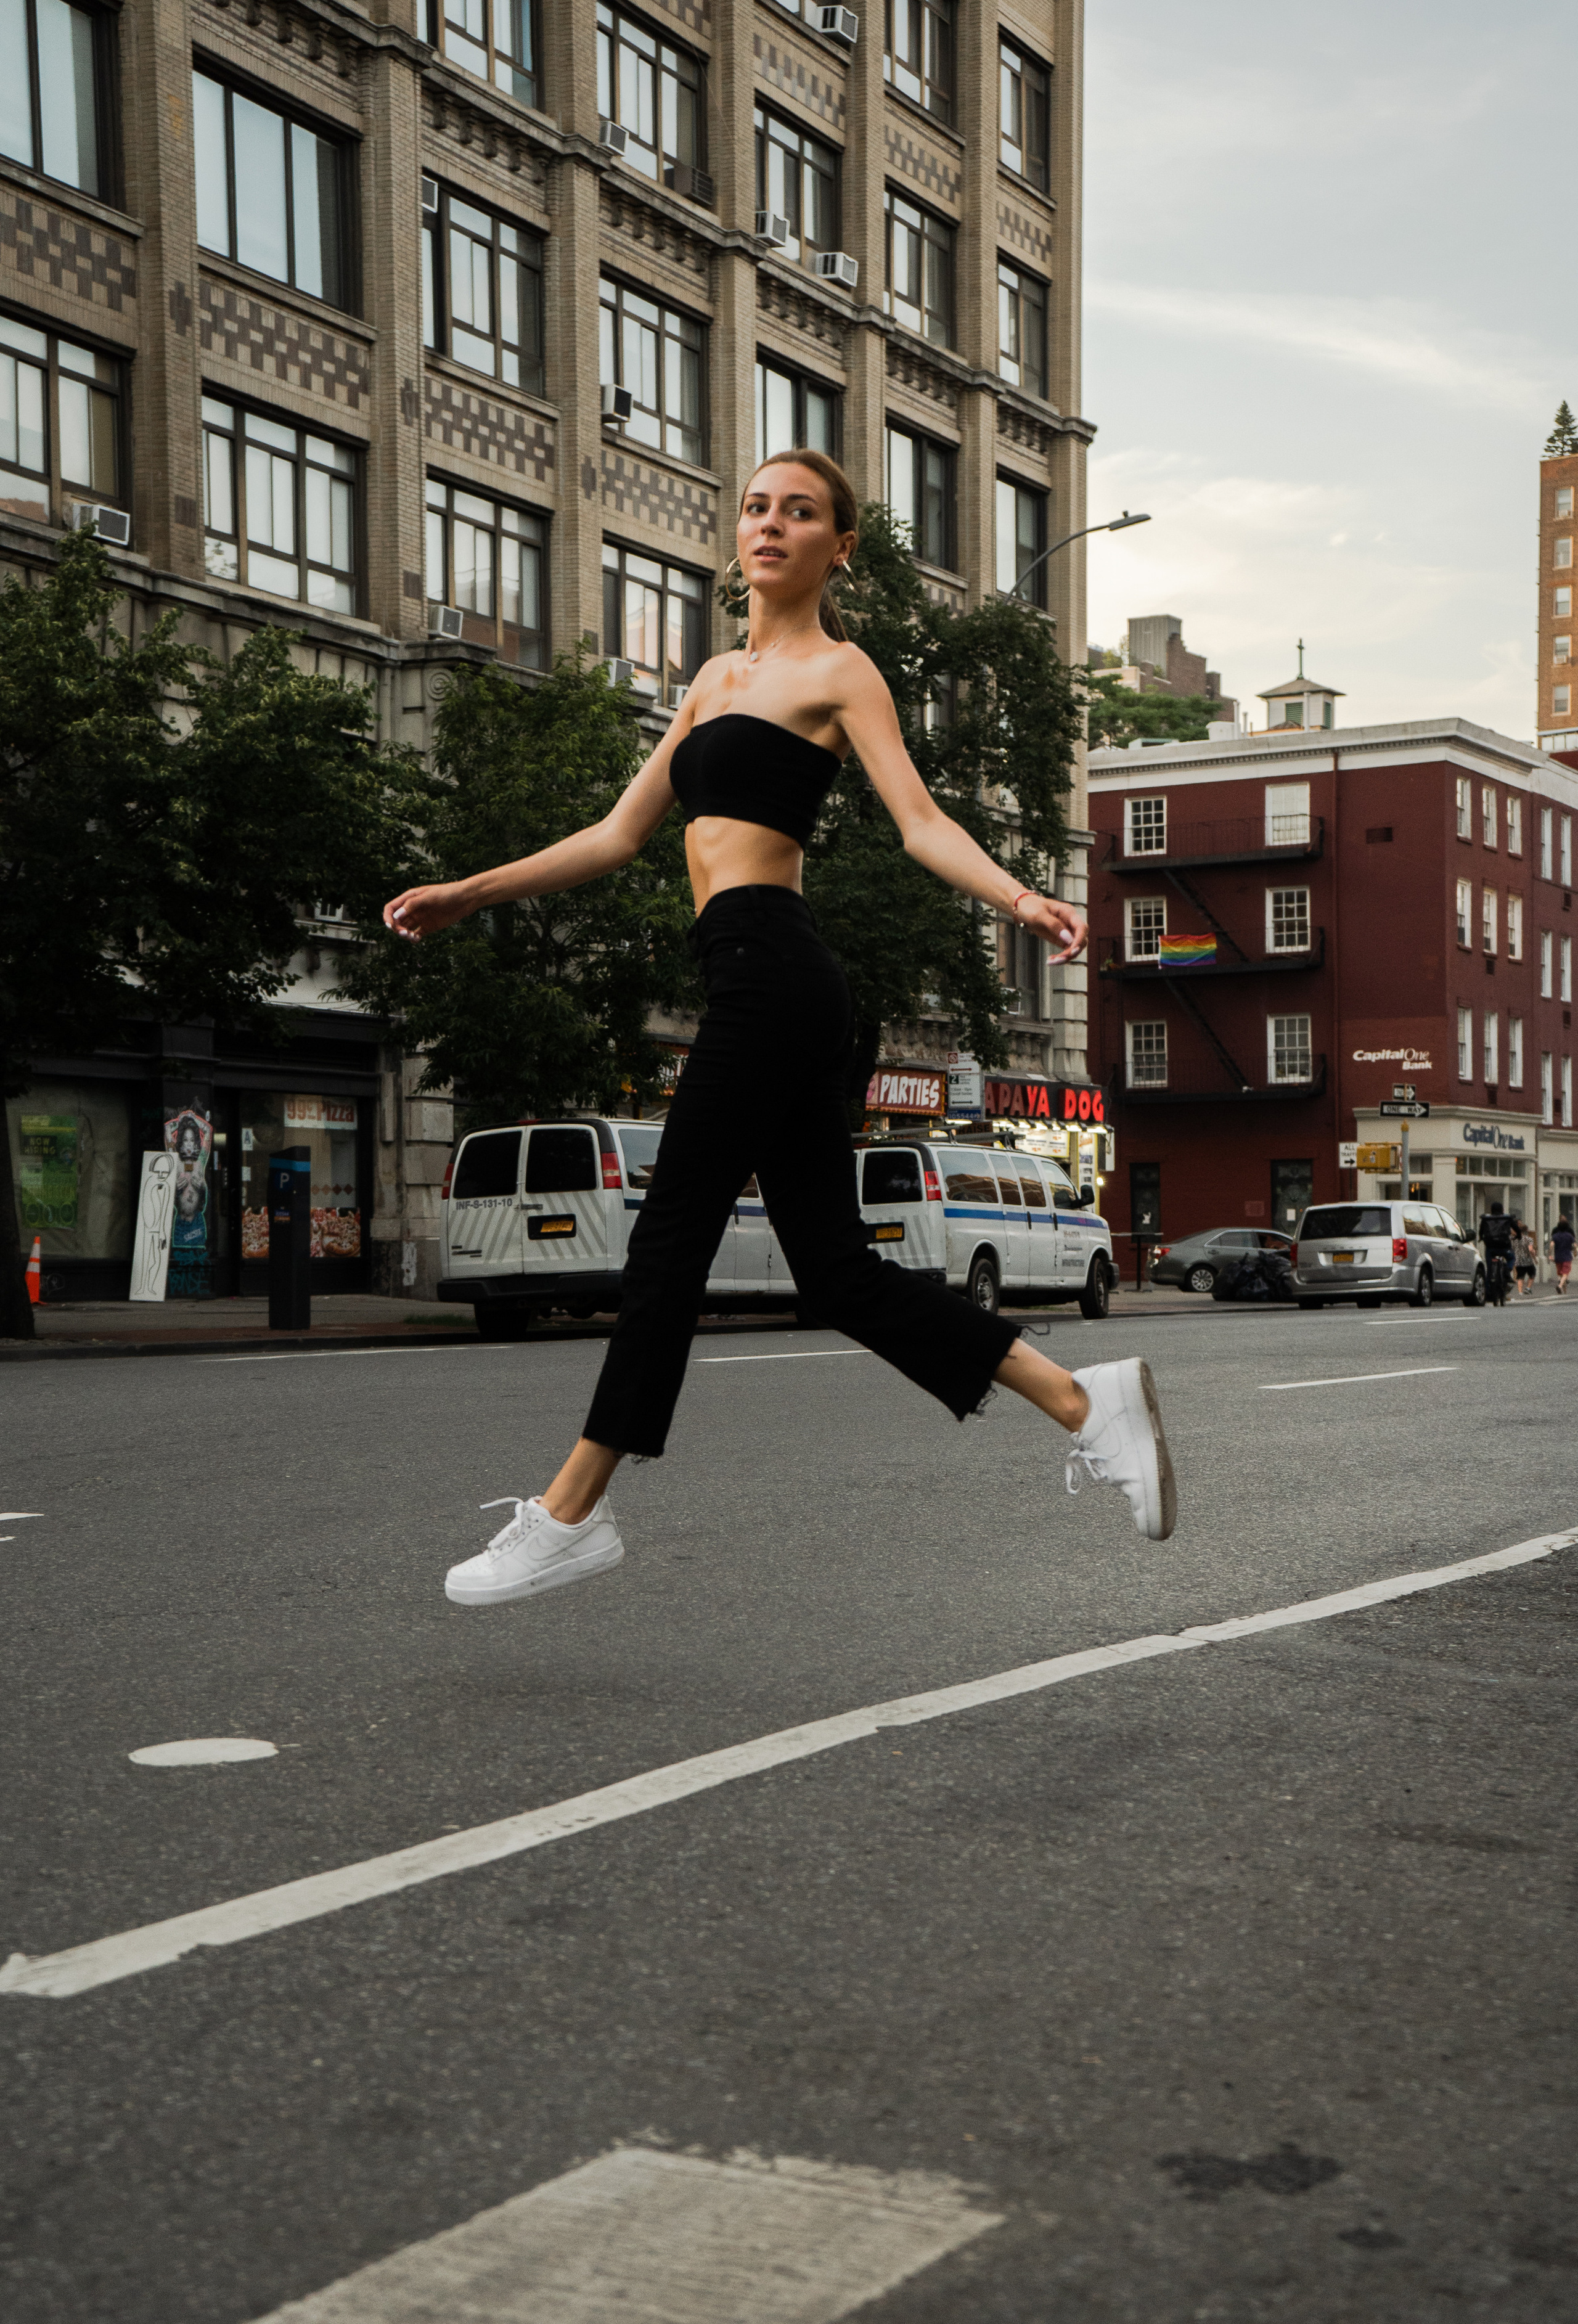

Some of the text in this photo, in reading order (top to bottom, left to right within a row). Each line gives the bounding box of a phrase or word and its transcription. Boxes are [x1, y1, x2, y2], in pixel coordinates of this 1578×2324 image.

[1402, 1061, 1433, 1070] Bank
[879, 1074, 939, 1108] PARTIES
[985, 1082, 1104, 1122] APAYA DOG
[1387, 1105, 1400, 1113] ONE
[280, 1172, 290, 1189] P
[456, 1198, 512, 1210] INF-S-131-10
